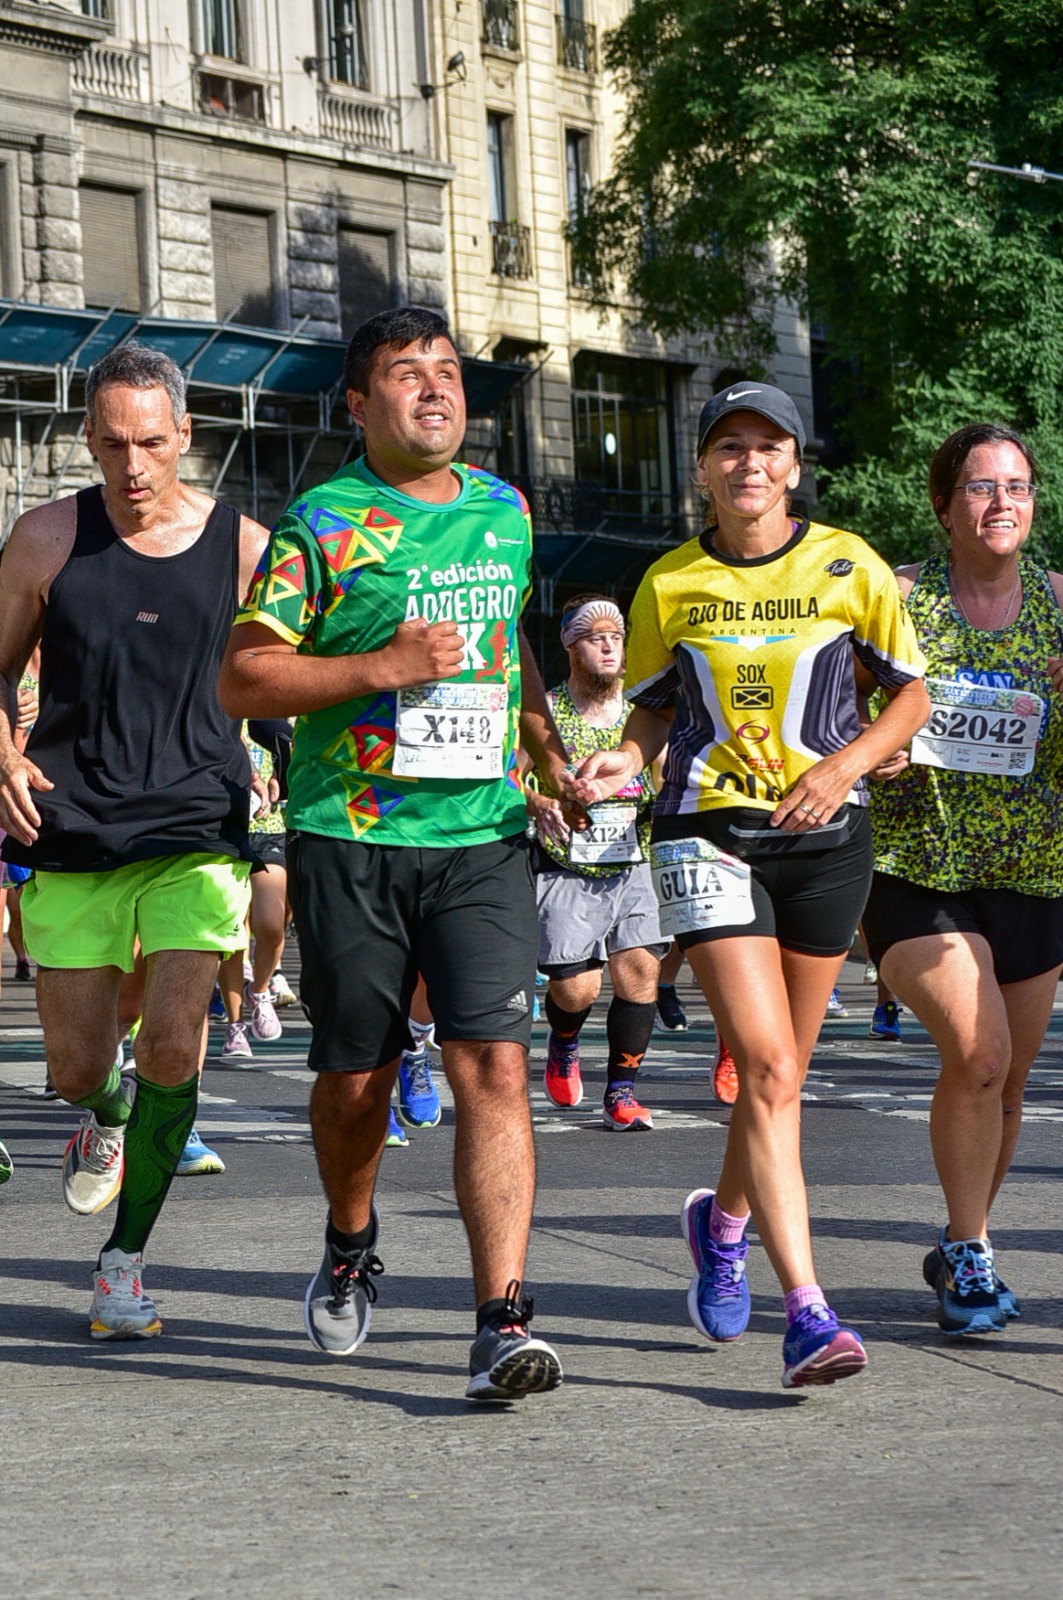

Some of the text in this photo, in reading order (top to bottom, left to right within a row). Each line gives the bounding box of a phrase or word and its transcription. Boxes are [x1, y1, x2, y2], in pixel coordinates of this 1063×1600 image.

[430, 559, 513, 587] edición
[687, 596, 819, 626] OJO DE AGUILA
[709, 627, 796, 636] ARGENTINA
[737, 664, 766, 684] SOX
[930, 709, 1027, 745] S2042
[586, 826, 628, 843] X124
